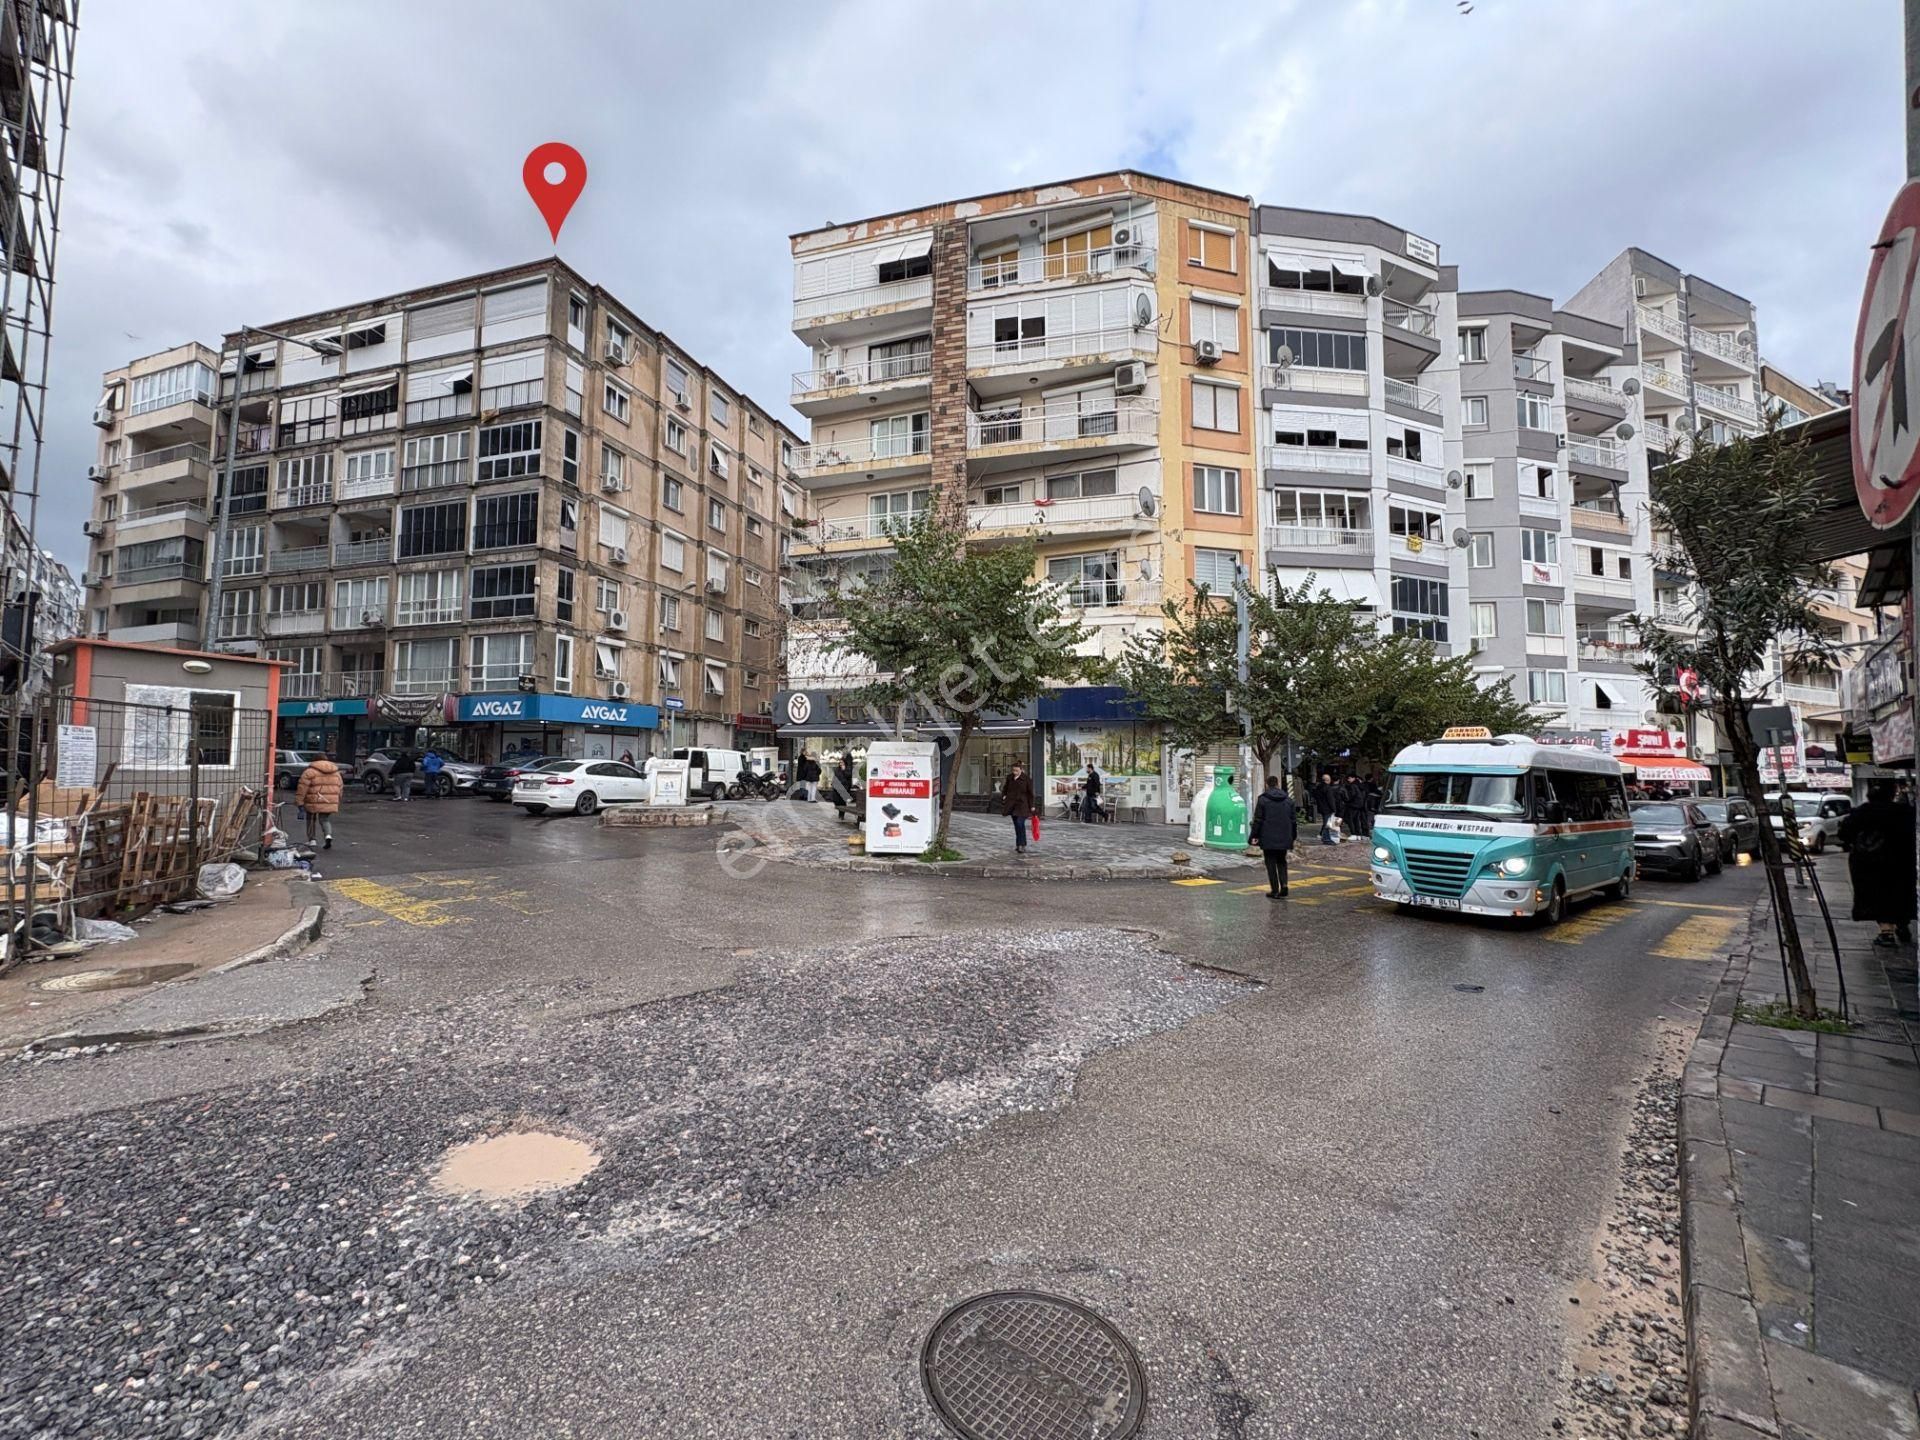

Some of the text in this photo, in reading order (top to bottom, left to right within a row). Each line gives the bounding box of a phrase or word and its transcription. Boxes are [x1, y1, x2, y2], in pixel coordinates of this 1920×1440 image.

[472, 701, 522, 716] AYGAZ
[581, 705, 628, 722] AYGAZ
[1456, 823, 1494, 833] WESTPARK
